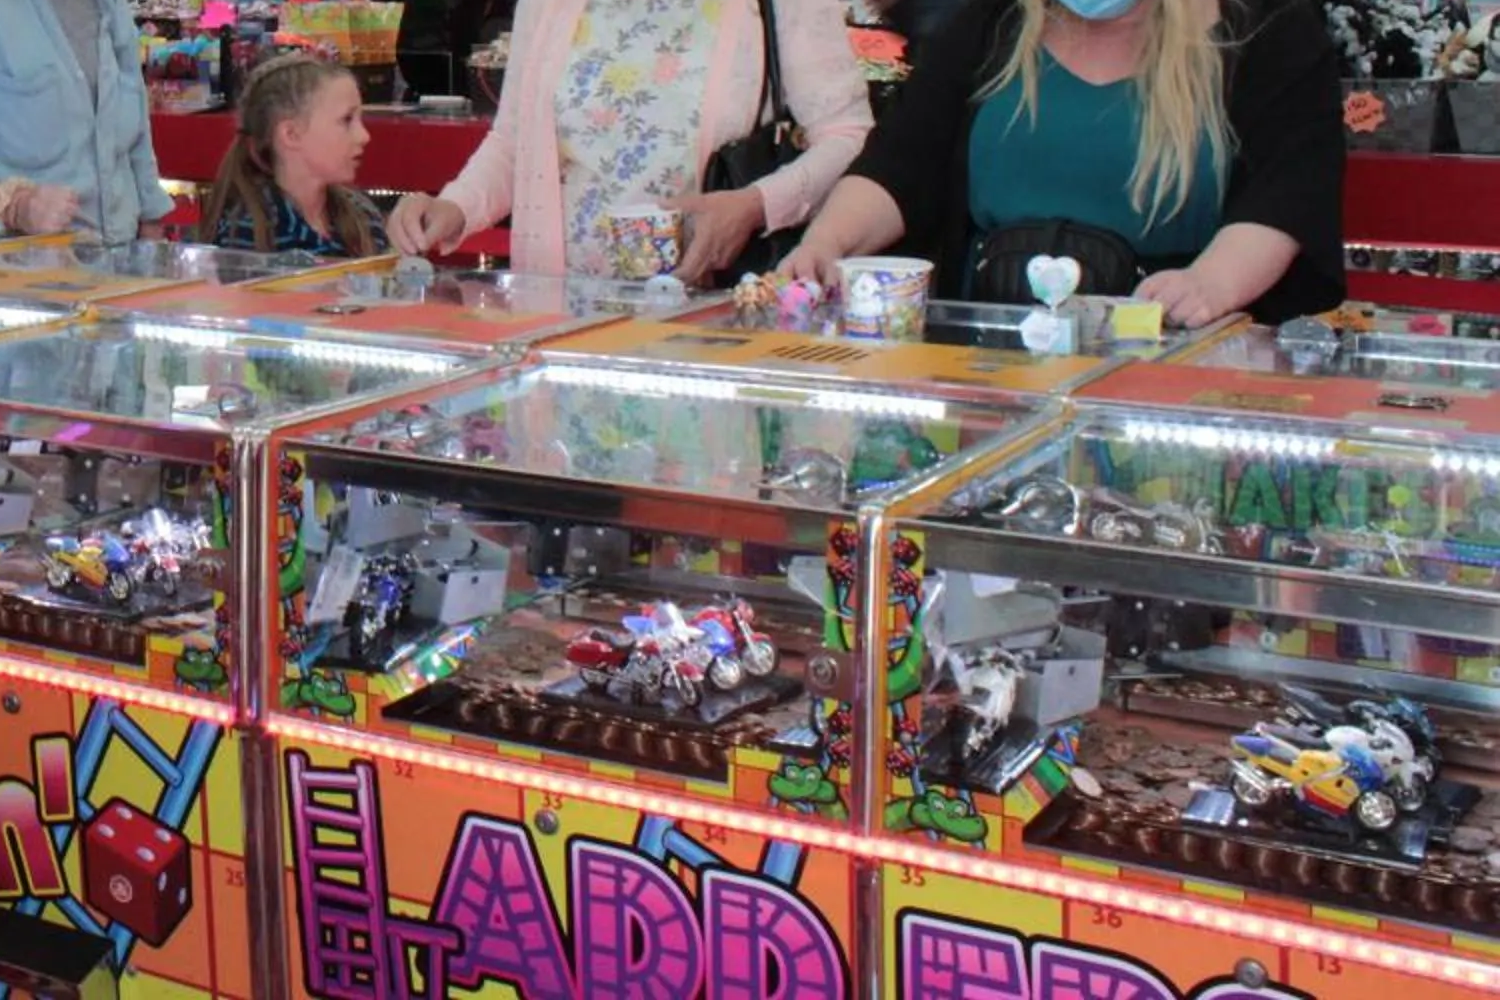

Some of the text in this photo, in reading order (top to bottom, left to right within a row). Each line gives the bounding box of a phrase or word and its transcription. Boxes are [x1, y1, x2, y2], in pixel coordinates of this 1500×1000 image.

[541, 791, 563, 810] 33
[224, 867, 245, 888] 25
[900, 866, 926, 886] 35
[1091, 906, 1123, 928] 36
[1316, 952, 1343, 975] 13
